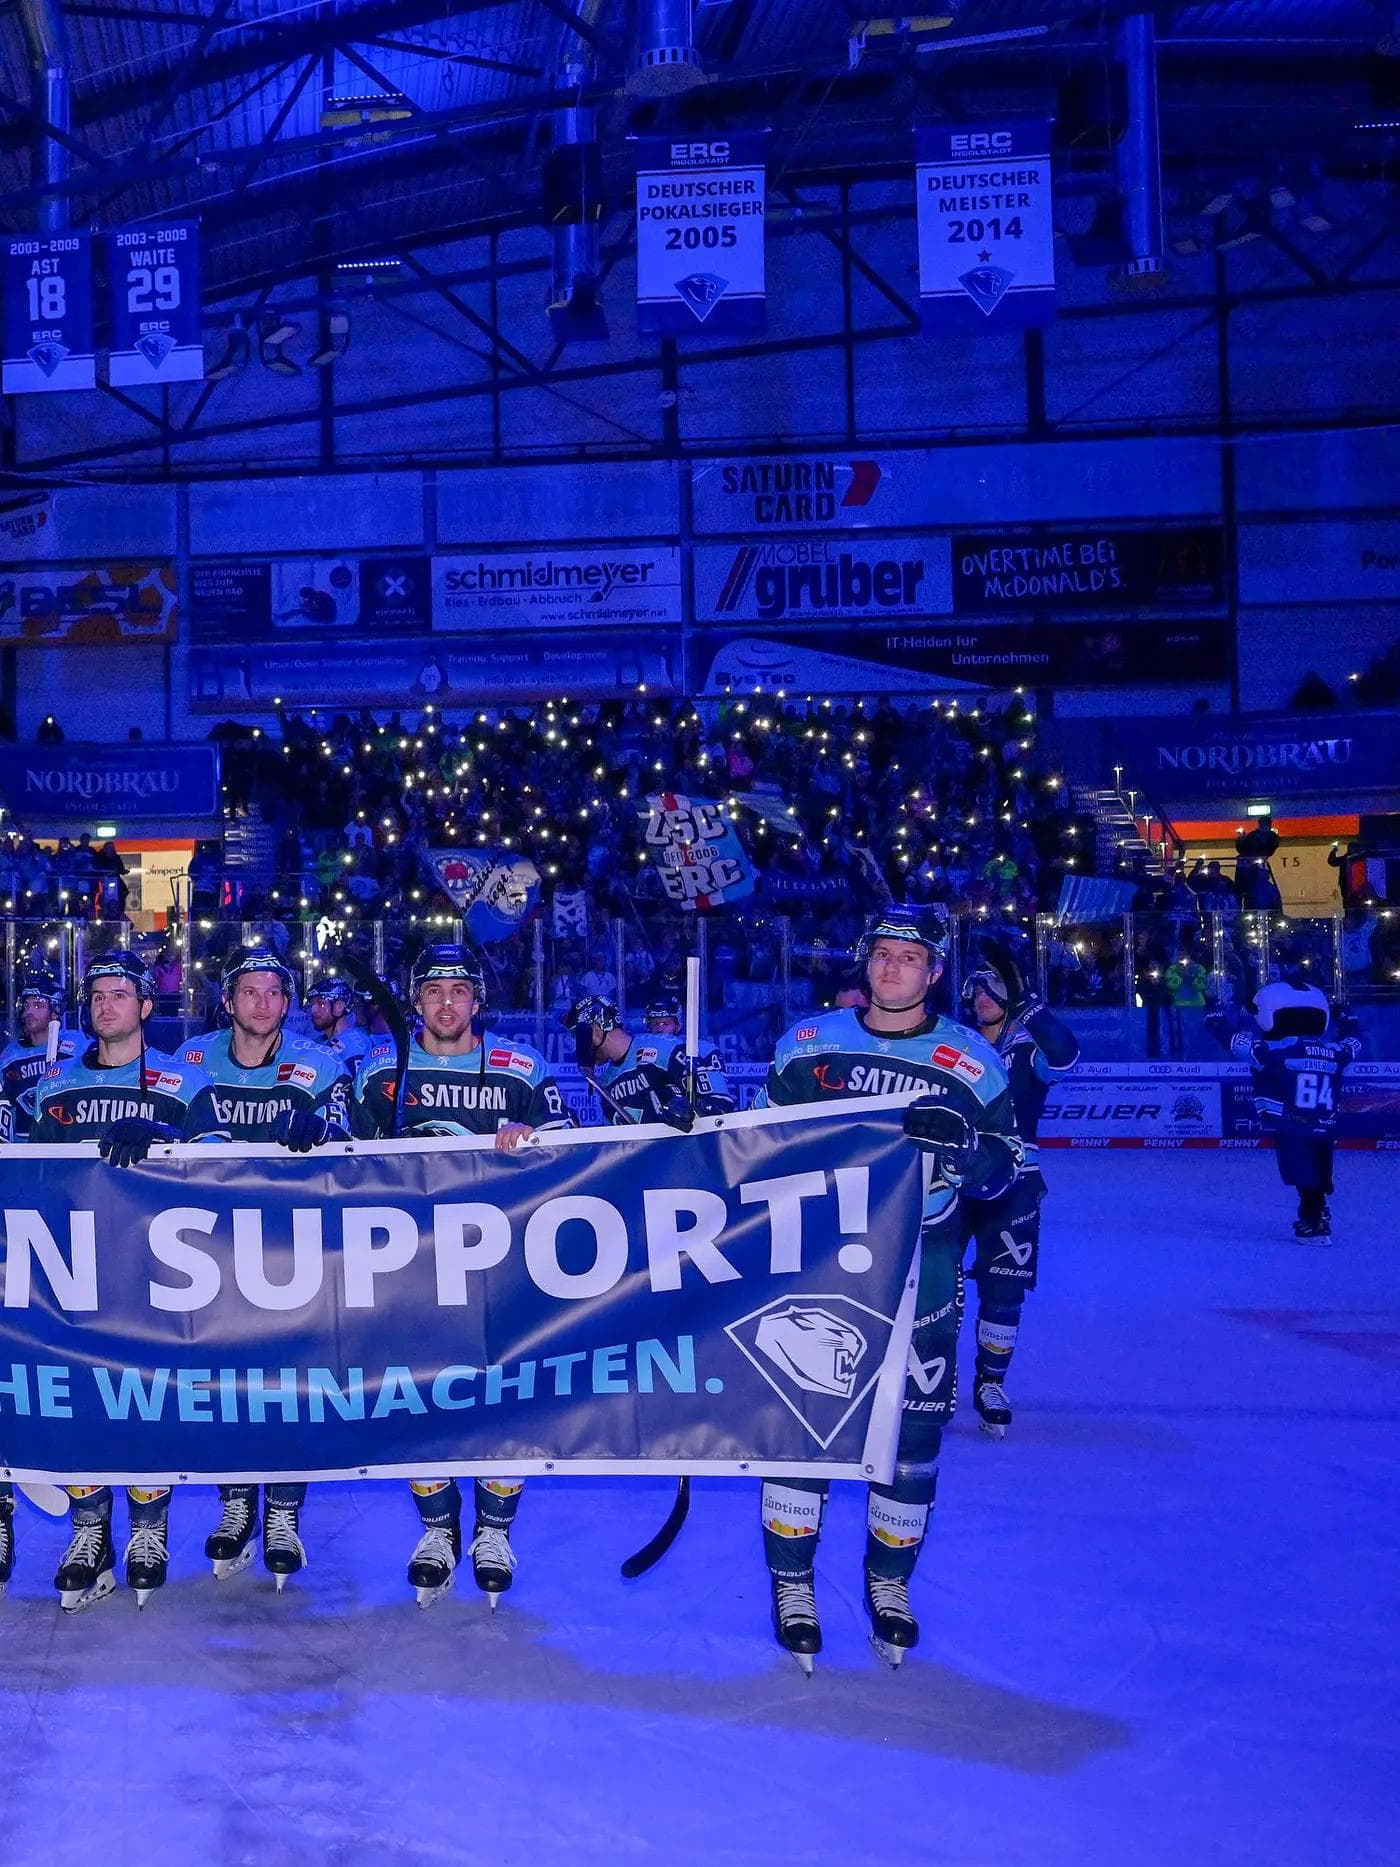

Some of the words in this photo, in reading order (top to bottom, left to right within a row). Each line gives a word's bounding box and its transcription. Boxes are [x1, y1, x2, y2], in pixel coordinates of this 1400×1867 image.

[670, 141, 730, 158] ERC
[950, 131, 1012, 150] ERC
[648, 180, 756, 199] DEUTSCHER
[928, 170, 1040, 191] DEUTSCHER
[640, 200, 763, 220] POKALSIEGER
[940, 193, 1030, 213] MEISTER
[665, 225, 737, 250] 2005
[947, 216, 1024, 243] 2014
[31, 258, 60, 275] AST
[130, 248, 176, 266] WAITE
[26, 276, 66, 320] 18
[127, 266, 180, 313] 29
[32, 330, 62, 340] ERC
[140, 320, 170, 331] ERC
[721, 461, 835, 493] SATURN
[755, 493, 835, 523] CARD
[444, 560, 655, 602] schmidmeyer
[755, 553, 924, 617] gruber
[530, 592, 581, 604] Abbruch
[952, 651, 1049, 666] Unternehmen
[1158, 738, 1353, 774] NORDBRÄU
[25, 768, 180, 798] NORDBRÄU
[657, 859, 743, 900] ERC
[20, 1060, 47, 1079] SATU
[1087, 1065, 1111, 1073] Audi
[1175, 1065, 1200, 1073] Audi
[1227, 1065, 1249, 1073] Aud
[420, 1083, 507, 1111] SATURN
[1295, 1073, 1334, 1110] 64
[76, 1099, 155, 1124] SATURN
[1041, 1104, 1161, 1120] BAUER
[1071, 1138, 1111, 1148] PENNY
[1144, 1138, 1183, 1148] PENNY
[1219, 1139, 1260, 1148] PENNY
[1376, 1140, 1400, 1149] PEN
[148, 1166, 873, 1311] SUPPORT!
[989, 1266, 1033, 1279] BAUER
[93, 1335, 724, 1423] WEIHNACHTEN.
